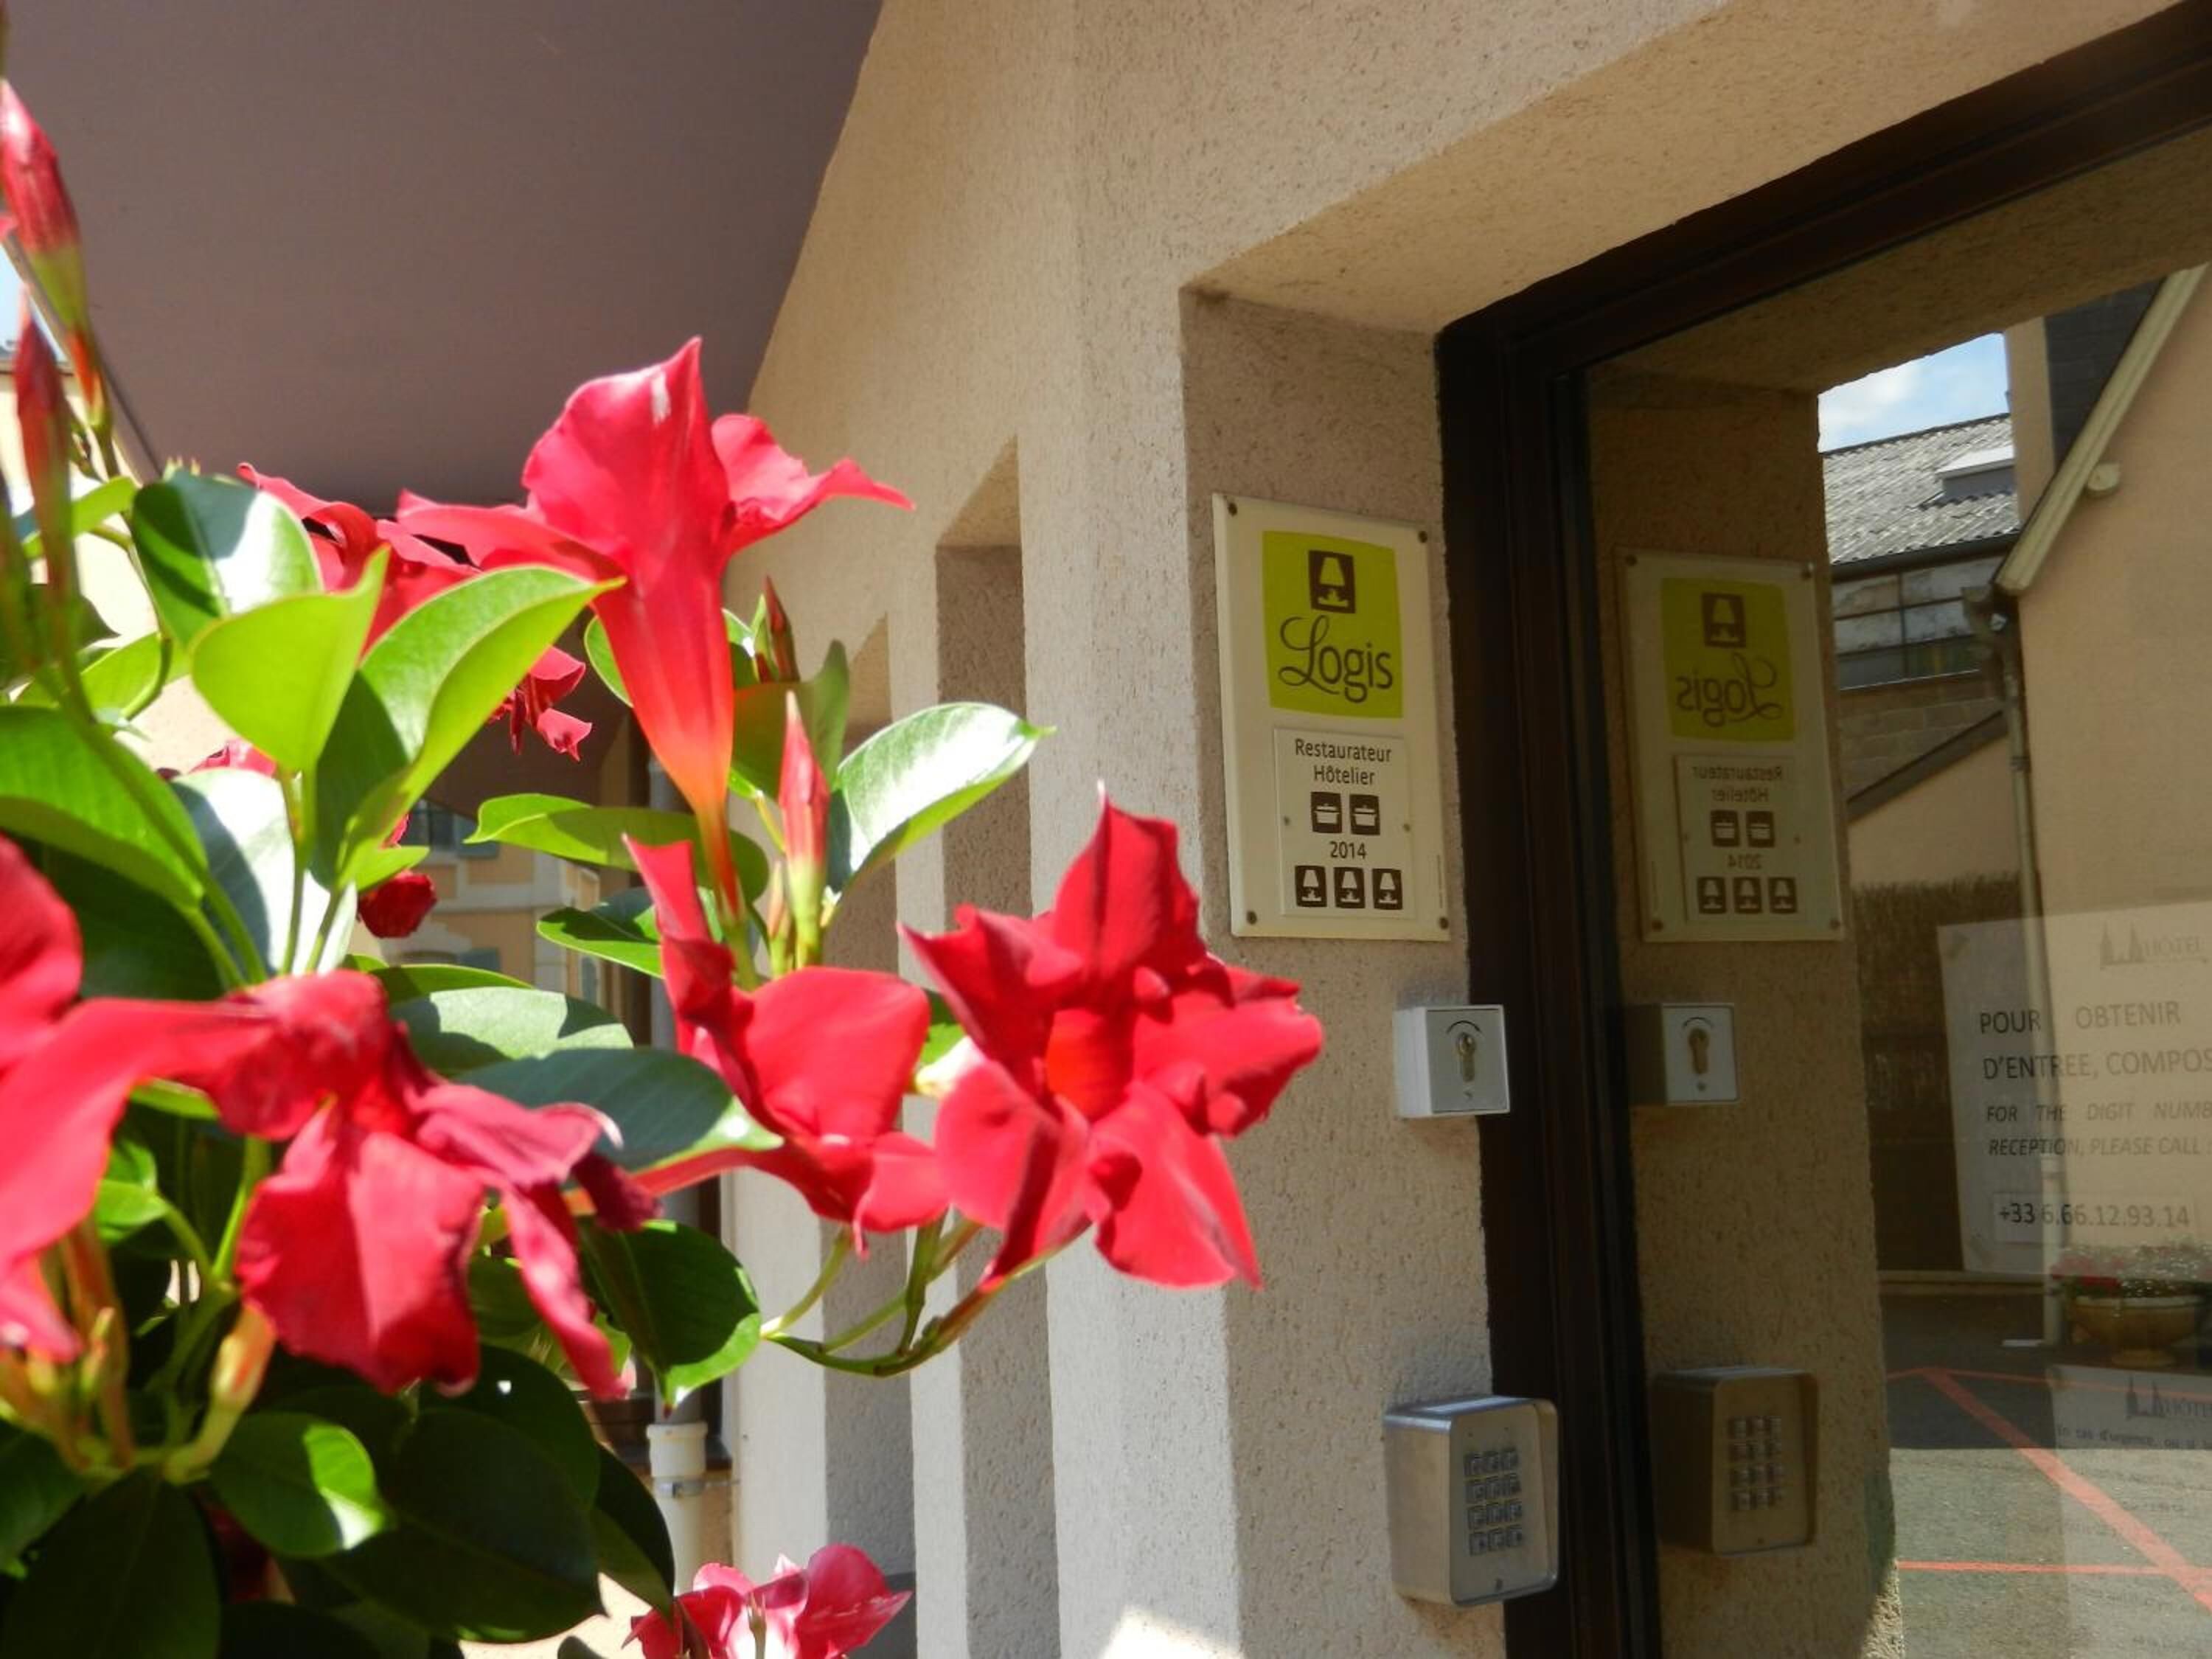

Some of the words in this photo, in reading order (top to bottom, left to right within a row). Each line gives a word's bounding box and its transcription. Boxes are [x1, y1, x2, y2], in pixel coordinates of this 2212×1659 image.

[1279, 614, 1394, 703] Logis
[1295, 738, 1392, 763] Restaurateur
[1313, 765, 1376, 786] Hôtelier
[1329, 841, 1367, 860] 2014
[1980, 1009, 2041, 1035] POUR
[2076, 1001, 2183, 1029] OBTENIR
[1986, 1105, 2018, 1122] FOR
[2036, 1104, 2068, 1121] THE
[2087, 1102, 2137, 1121] DIGIT
[2090, 1137, 2152, 1155] PLEASE
